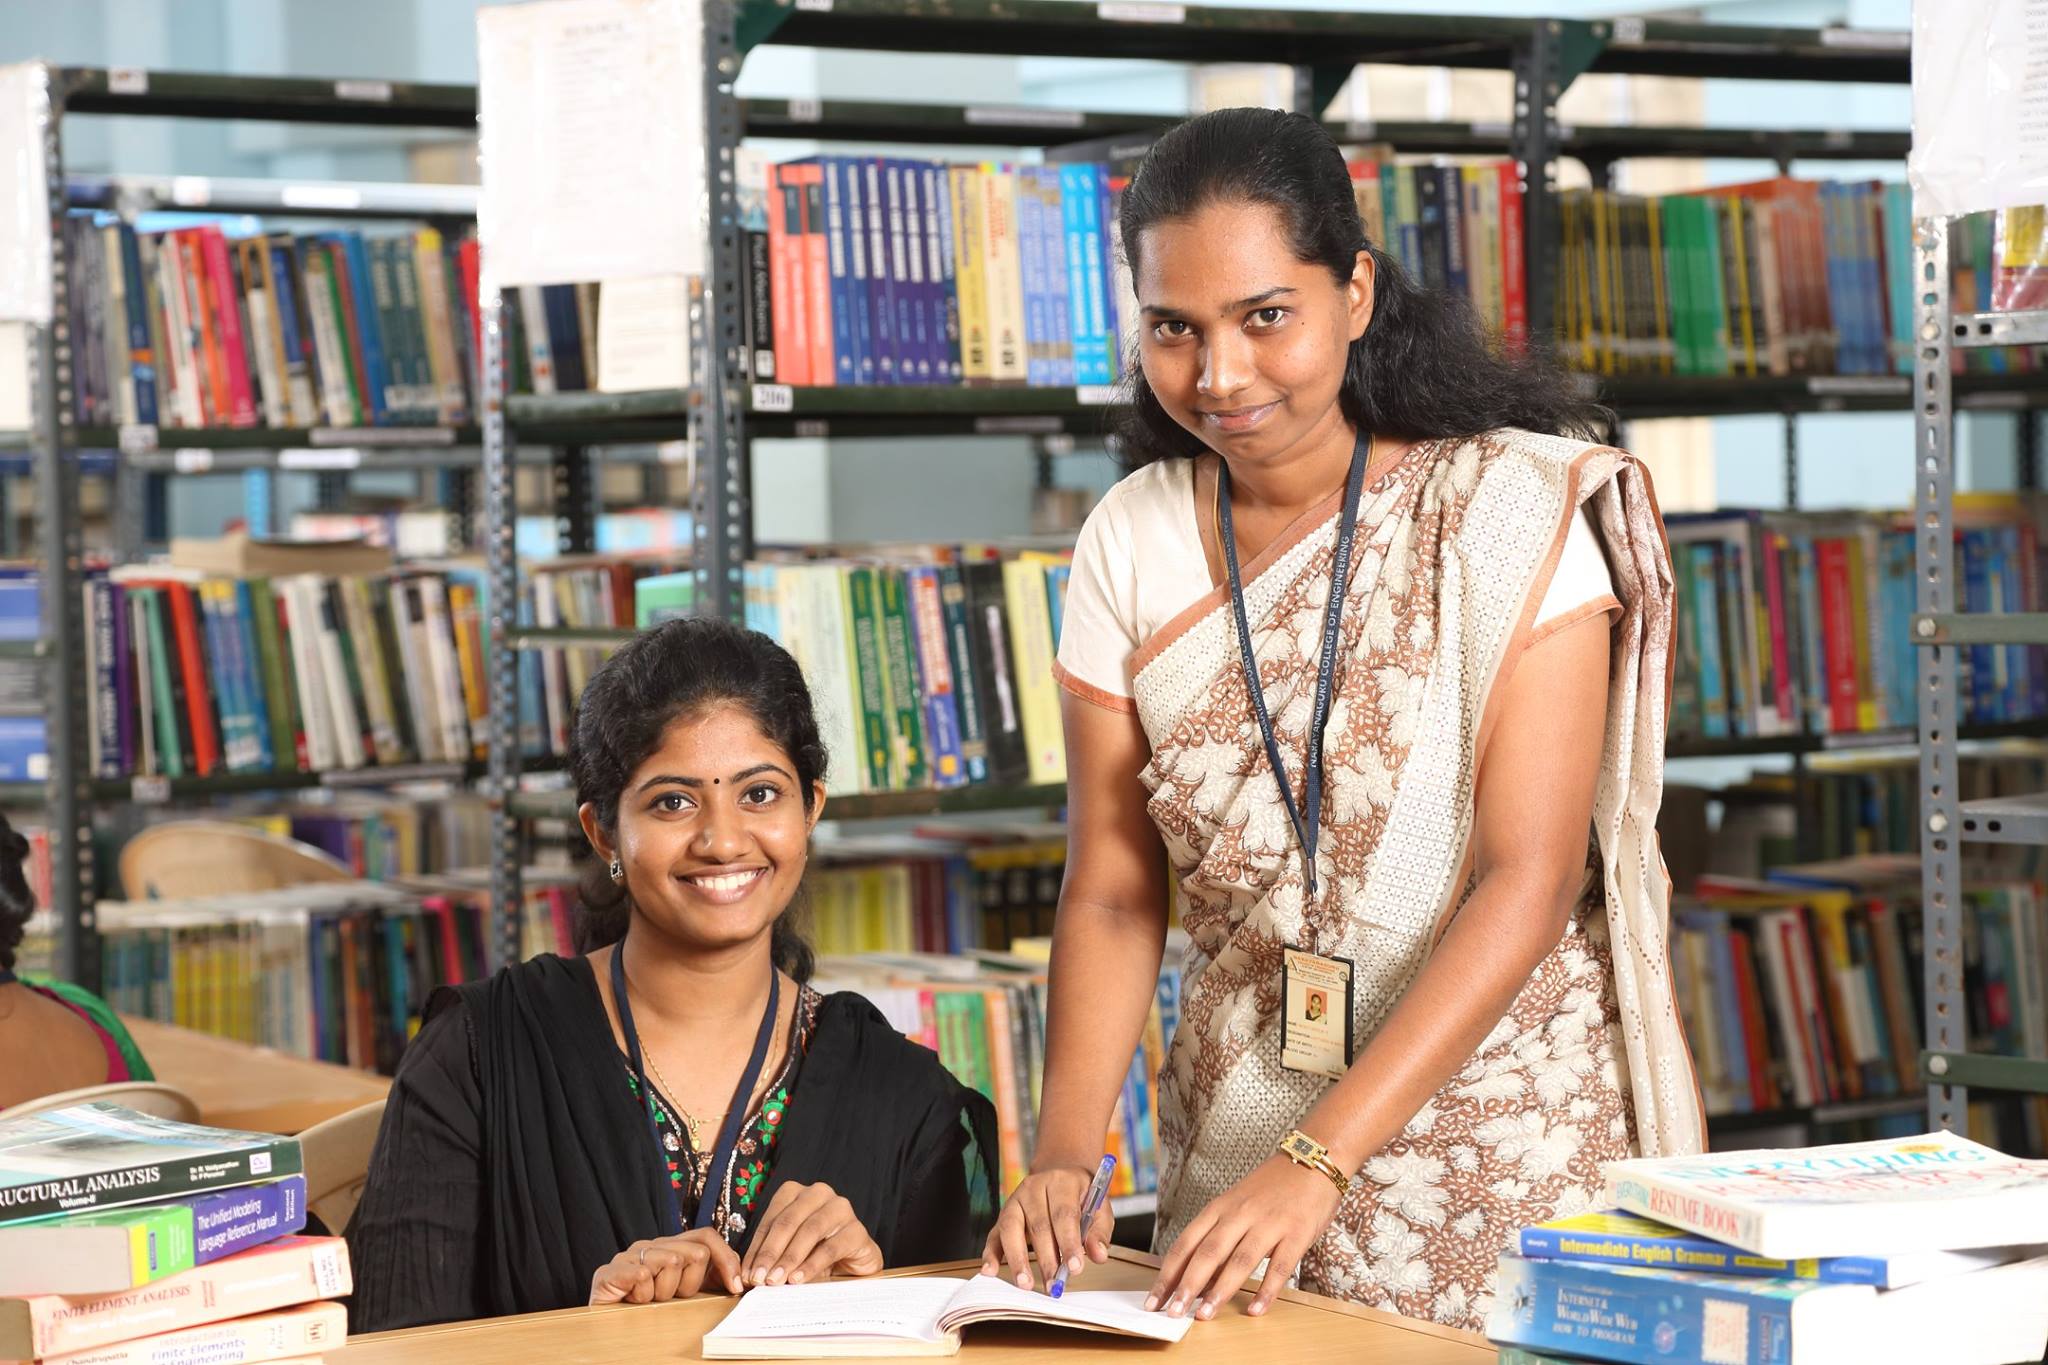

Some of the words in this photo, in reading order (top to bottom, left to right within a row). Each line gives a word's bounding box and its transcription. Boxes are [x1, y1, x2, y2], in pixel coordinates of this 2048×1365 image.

[1331, 536, 1350, 609] ENGINEERING
[1326, 611, 1338, 626] OF
[1320, 628, 1335, 677] COLLEGE
[1310, 679, 1328, 768] NARAYANAGURU
[86, 1166, 161, 1193] ANALYSIS
[198, 1215, 210, 1231] The
[209, 1206, 232, 1228] Unified
[232, 1199, 261, 1220] Modeling
[1651, 1187, 1700, 1224] RESUME
[1703, 1203, 1739, 1239] BOOK
[198, 1231, 226, 1252] Language
[226, 1222, 256, 1241] Reference
[256, 1211, 278, 1232] Manual
[1559, 1237, 1630, 1259] Intermediate
[1632, 1242, 1673, 1265] English
[1676, 1247, 1727, 1267] Grammar
[52, 1304, 87, 1321] FINITE
[88, 1294, 139, 1314] ELEMENT
[141, 1284, 191, 1305] ANALYSIS
[1558, 1288, 1599, 1307] INTERNET
[1557, 1303, 1590, 1324] WORLD
[1590, 1308, 1614, 1328] WIDE
[1615, 1312, 1638, 1331] WEB
[152, 1347, 185, 1361] Finite
[191, 1337, 246, 1354] Elements
[1552, 1323, 1573, 1335] HOW
[1577, 1326, 1590, 1338] TO
[1592, 1328, 1637, 1345] PROGRAM
